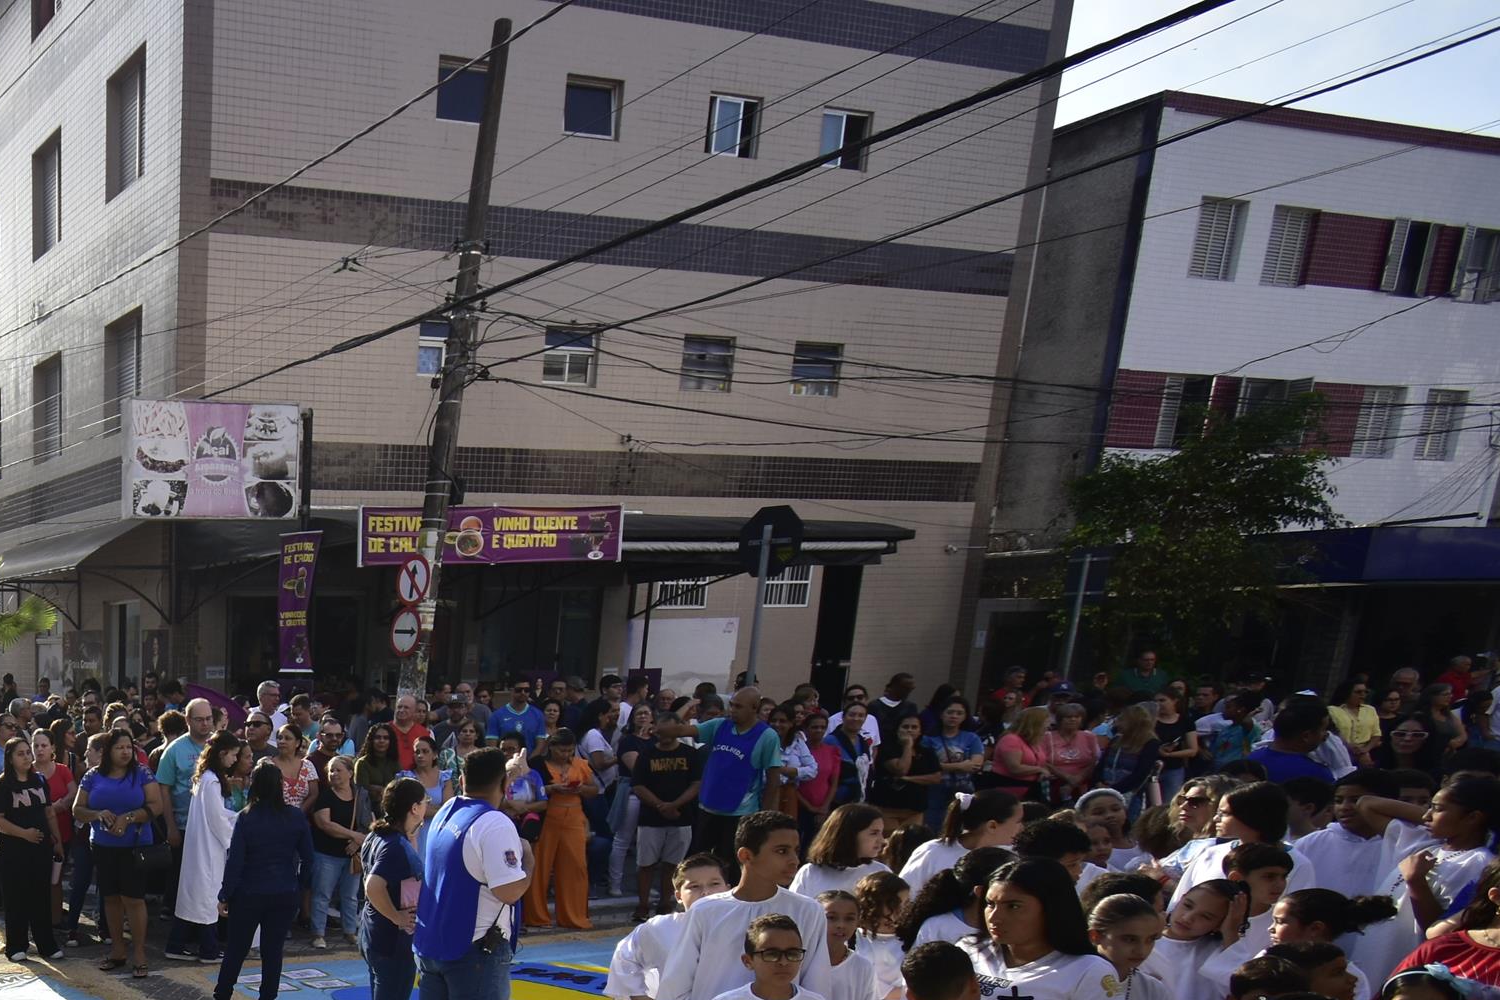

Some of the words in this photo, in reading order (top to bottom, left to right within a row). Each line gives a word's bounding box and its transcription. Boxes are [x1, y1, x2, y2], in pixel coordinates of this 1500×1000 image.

[368, 516, 422, 532] FESTIVA
[493, 517, 530, 531] VINHO
[533, 516, 578, 532] QUENTE
[368, 537, 385, 553] DE
[390, 537, 419, 553] CAL
[492, 534, 500, 549] E
[503, 530, 557, 550] QUENTÃO
[11, 787, 47, 808] NY
